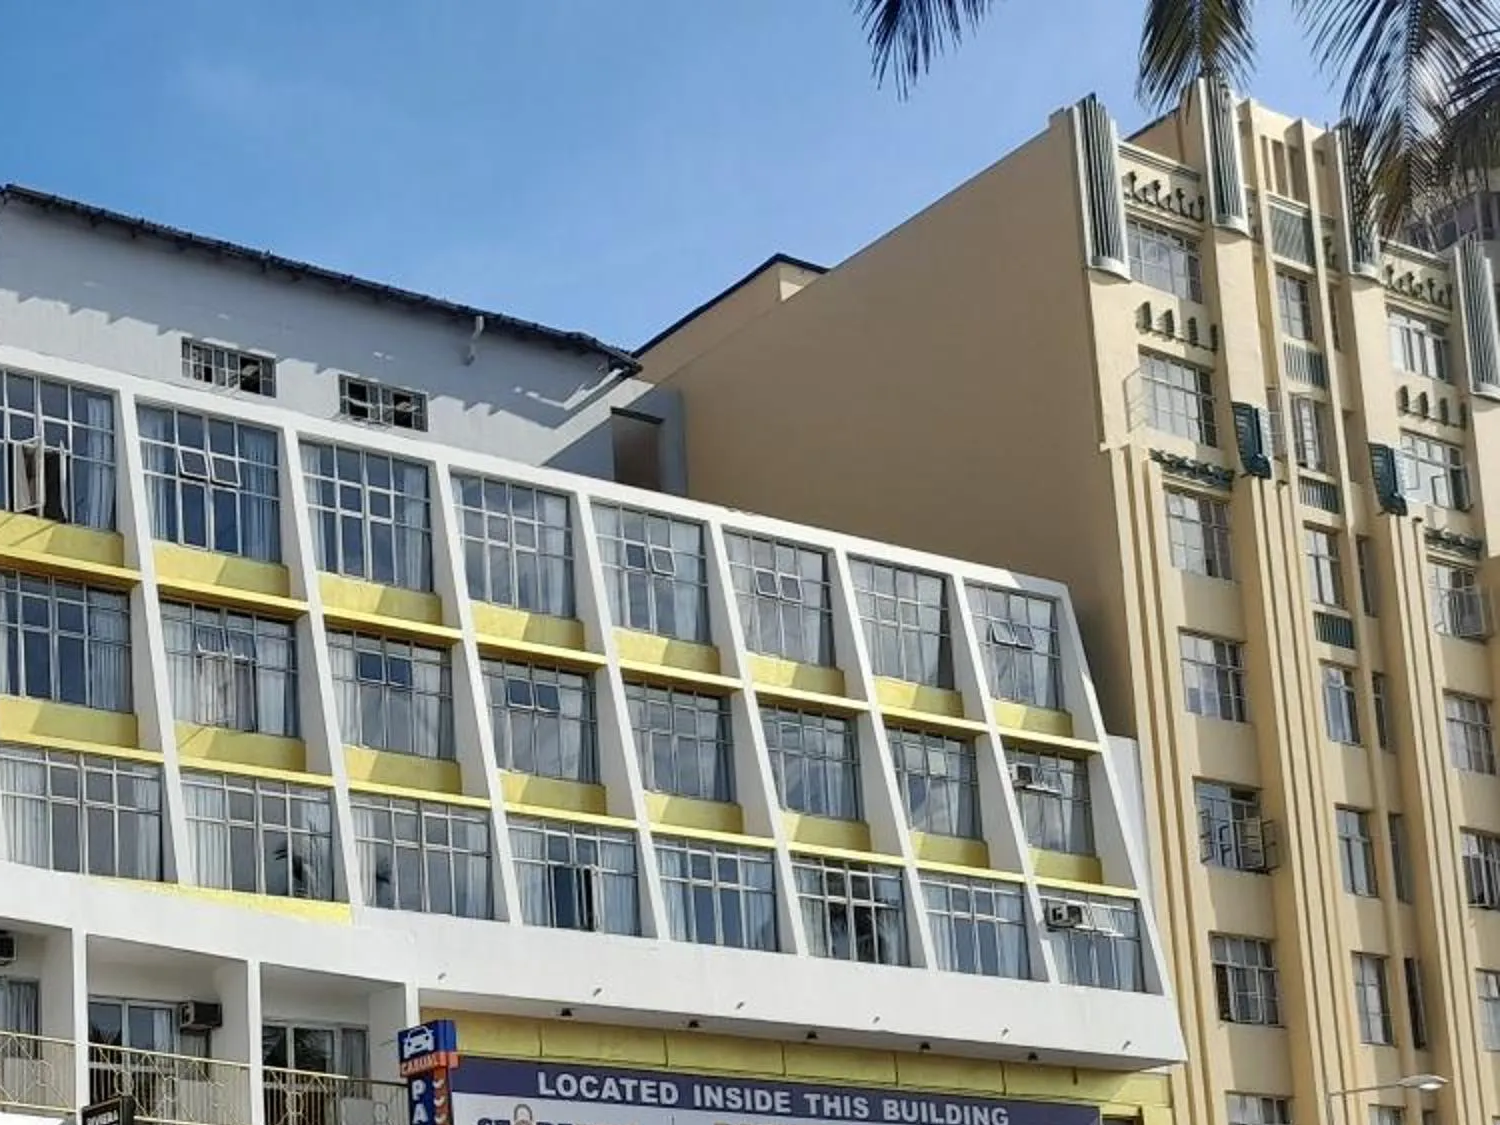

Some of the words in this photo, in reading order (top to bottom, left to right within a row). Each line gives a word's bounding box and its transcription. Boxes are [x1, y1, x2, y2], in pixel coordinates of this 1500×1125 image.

[537, 1072, 679, 1105] LOCATED
[693, 1084, 792, 1113] INSIDE
[803, 1093, 870, 1120] THIS
